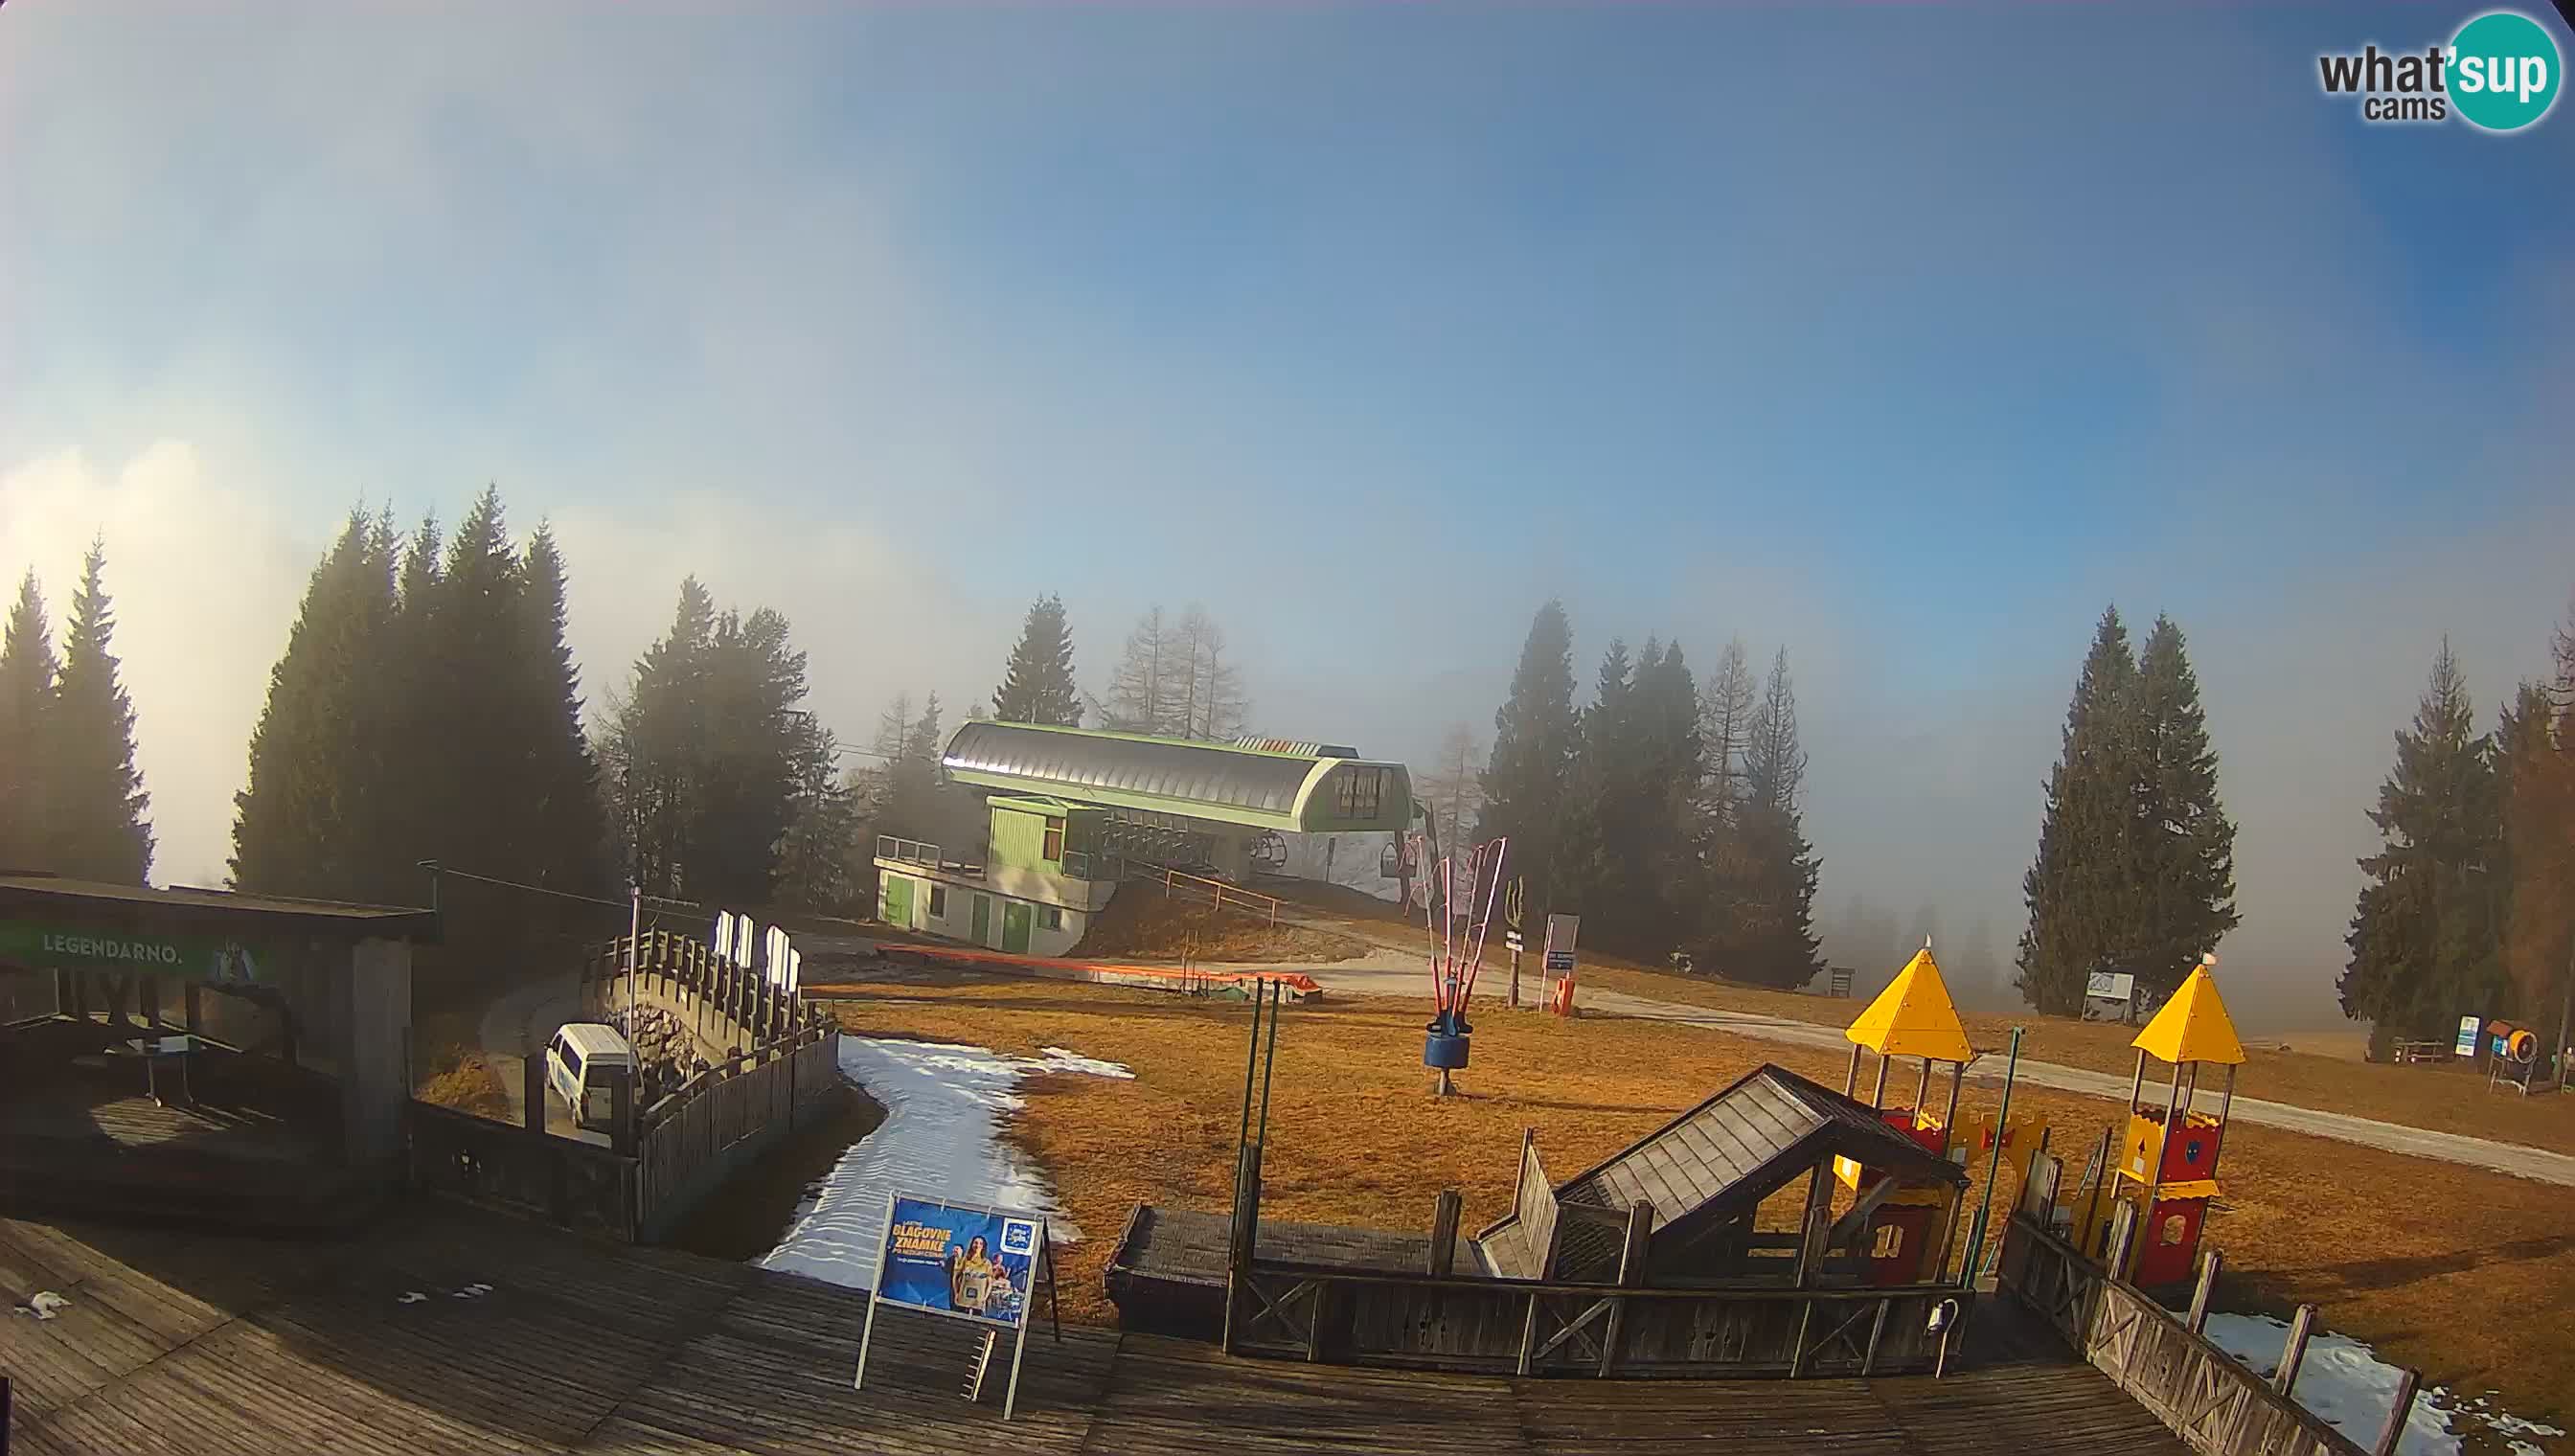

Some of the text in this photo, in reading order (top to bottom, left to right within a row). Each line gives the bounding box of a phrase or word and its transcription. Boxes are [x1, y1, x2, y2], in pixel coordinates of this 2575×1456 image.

[44, 935, 182, 965] LEGENDARNO.
[892, 1224, 951, 1241] BLAGOVNE
[895, 1237, 944, 1252] ZNAMKE
